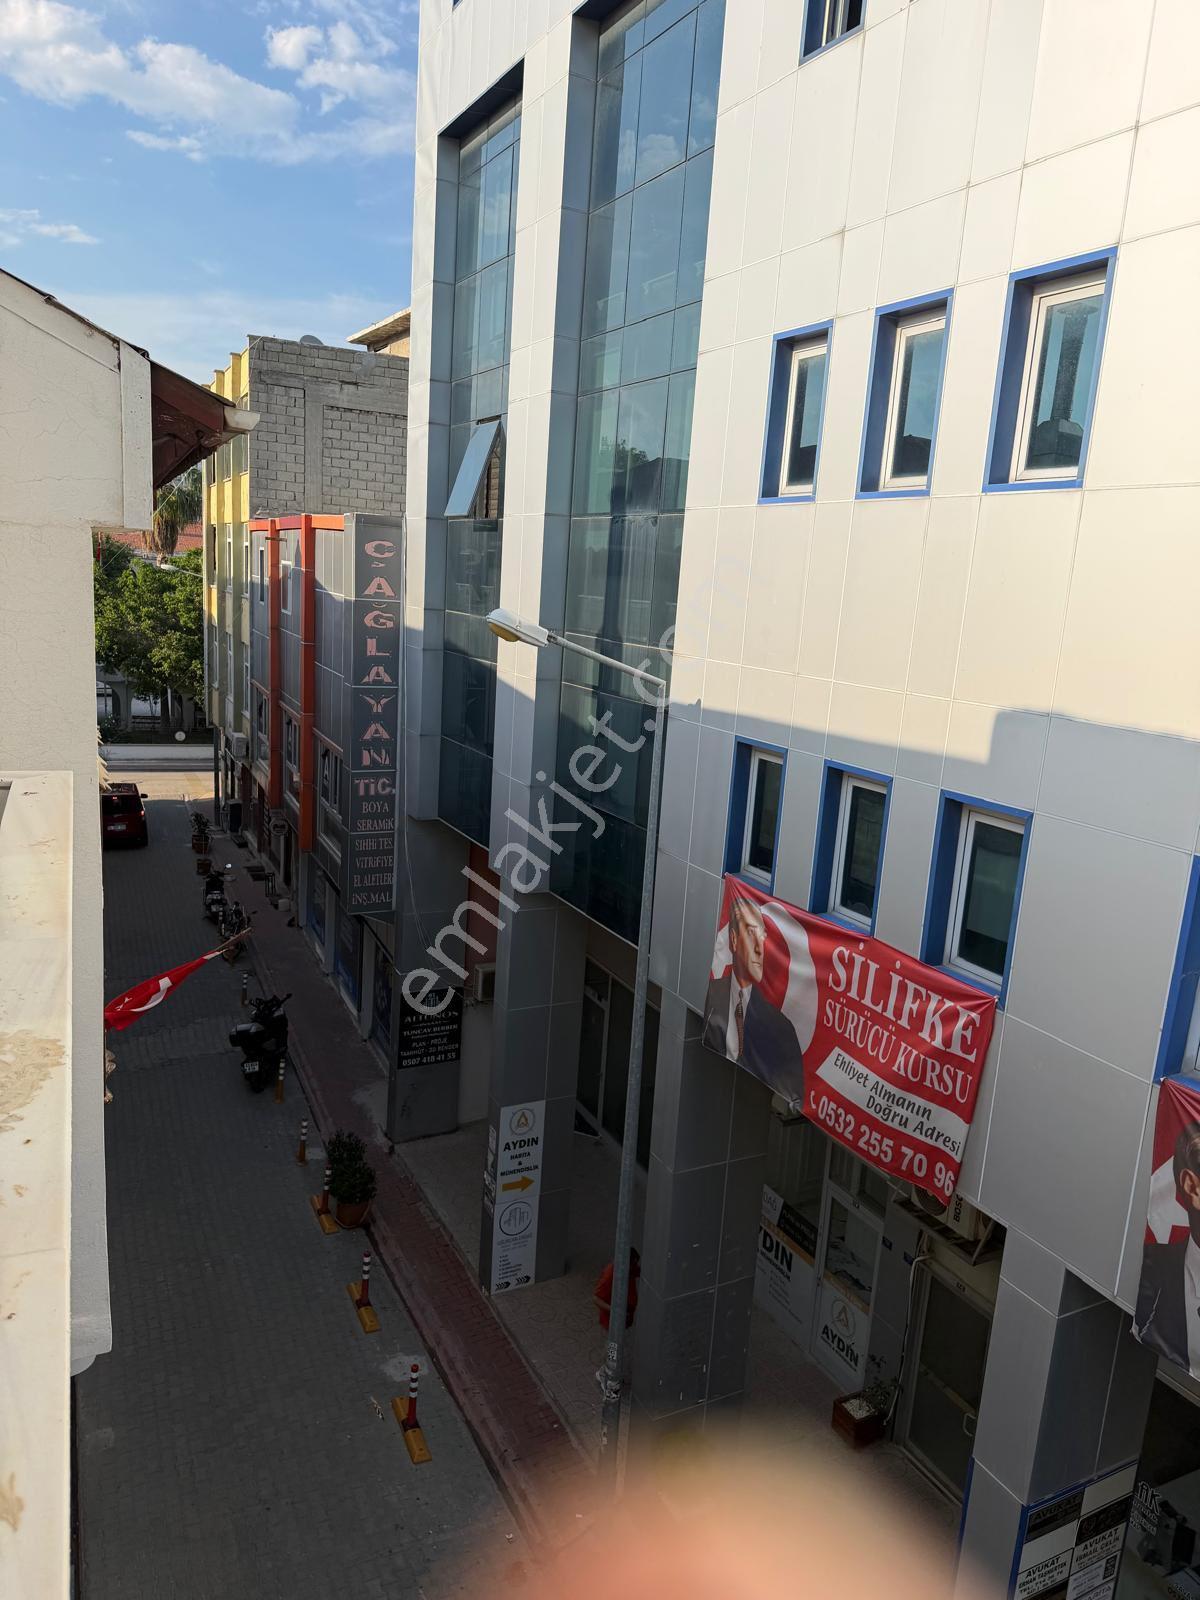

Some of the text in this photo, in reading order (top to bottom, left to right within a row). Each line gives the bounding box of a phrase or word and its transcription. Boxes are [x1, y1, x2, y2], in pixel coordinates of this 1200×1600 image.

[362, 801, 389, 813] BOYA
[353, 875, 362, 887] EL
[829, 942, 980, 1063] SİLİFKE
[823, 997, 973, 1103] SÜRÜCÜ KURSU
[834, 1053, 932, 1121] Ehliyet Almanın
[503, 1136, 539, 1152] AYDIN
[866, 1095, 961, 1156] Doğru Adresi
[817, 1096, 955, 1197] 0532 255 70 96
[953, 1193, 964, 1222] BOSC
[759, 1225, 793, 1273] DIN
[1083, 1527, 1120, 1551] AVUKAT
[1026, 1556, 1061, 1578] AVUKAT
